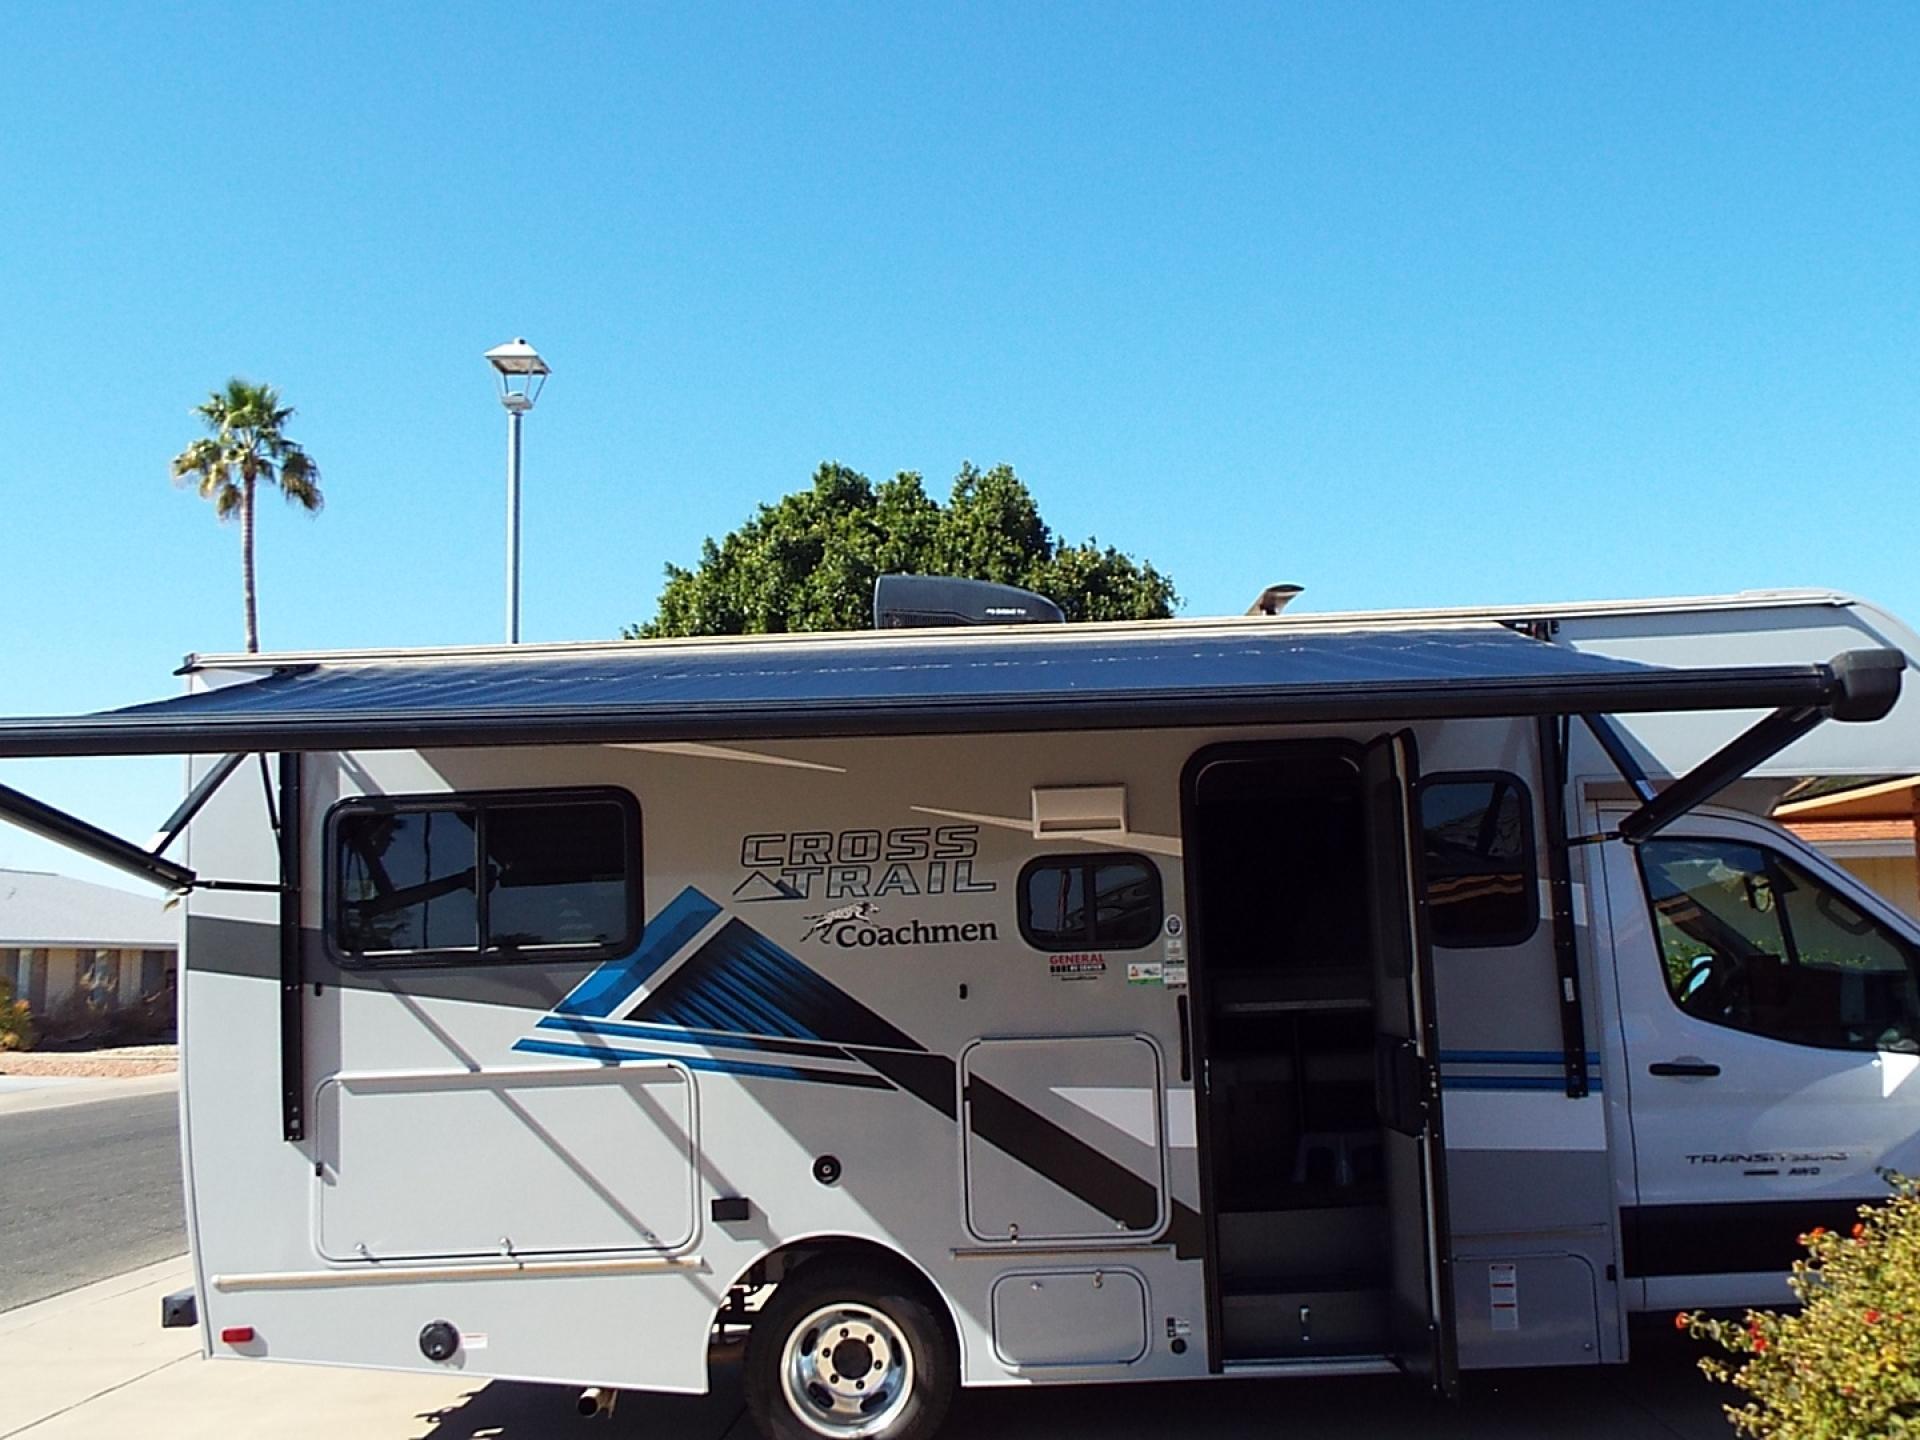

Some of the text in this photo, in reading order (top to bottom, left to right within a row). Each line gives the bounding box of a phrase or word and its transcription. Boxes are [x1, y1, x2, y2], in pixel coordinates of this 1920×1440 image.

[741, 825, 980, 868] CROSS
[781, 860, 997, 899] TRAIL
[836, 919, 998, 948] Coachmen
[1049, 953, 1105, 965] GENERAL
